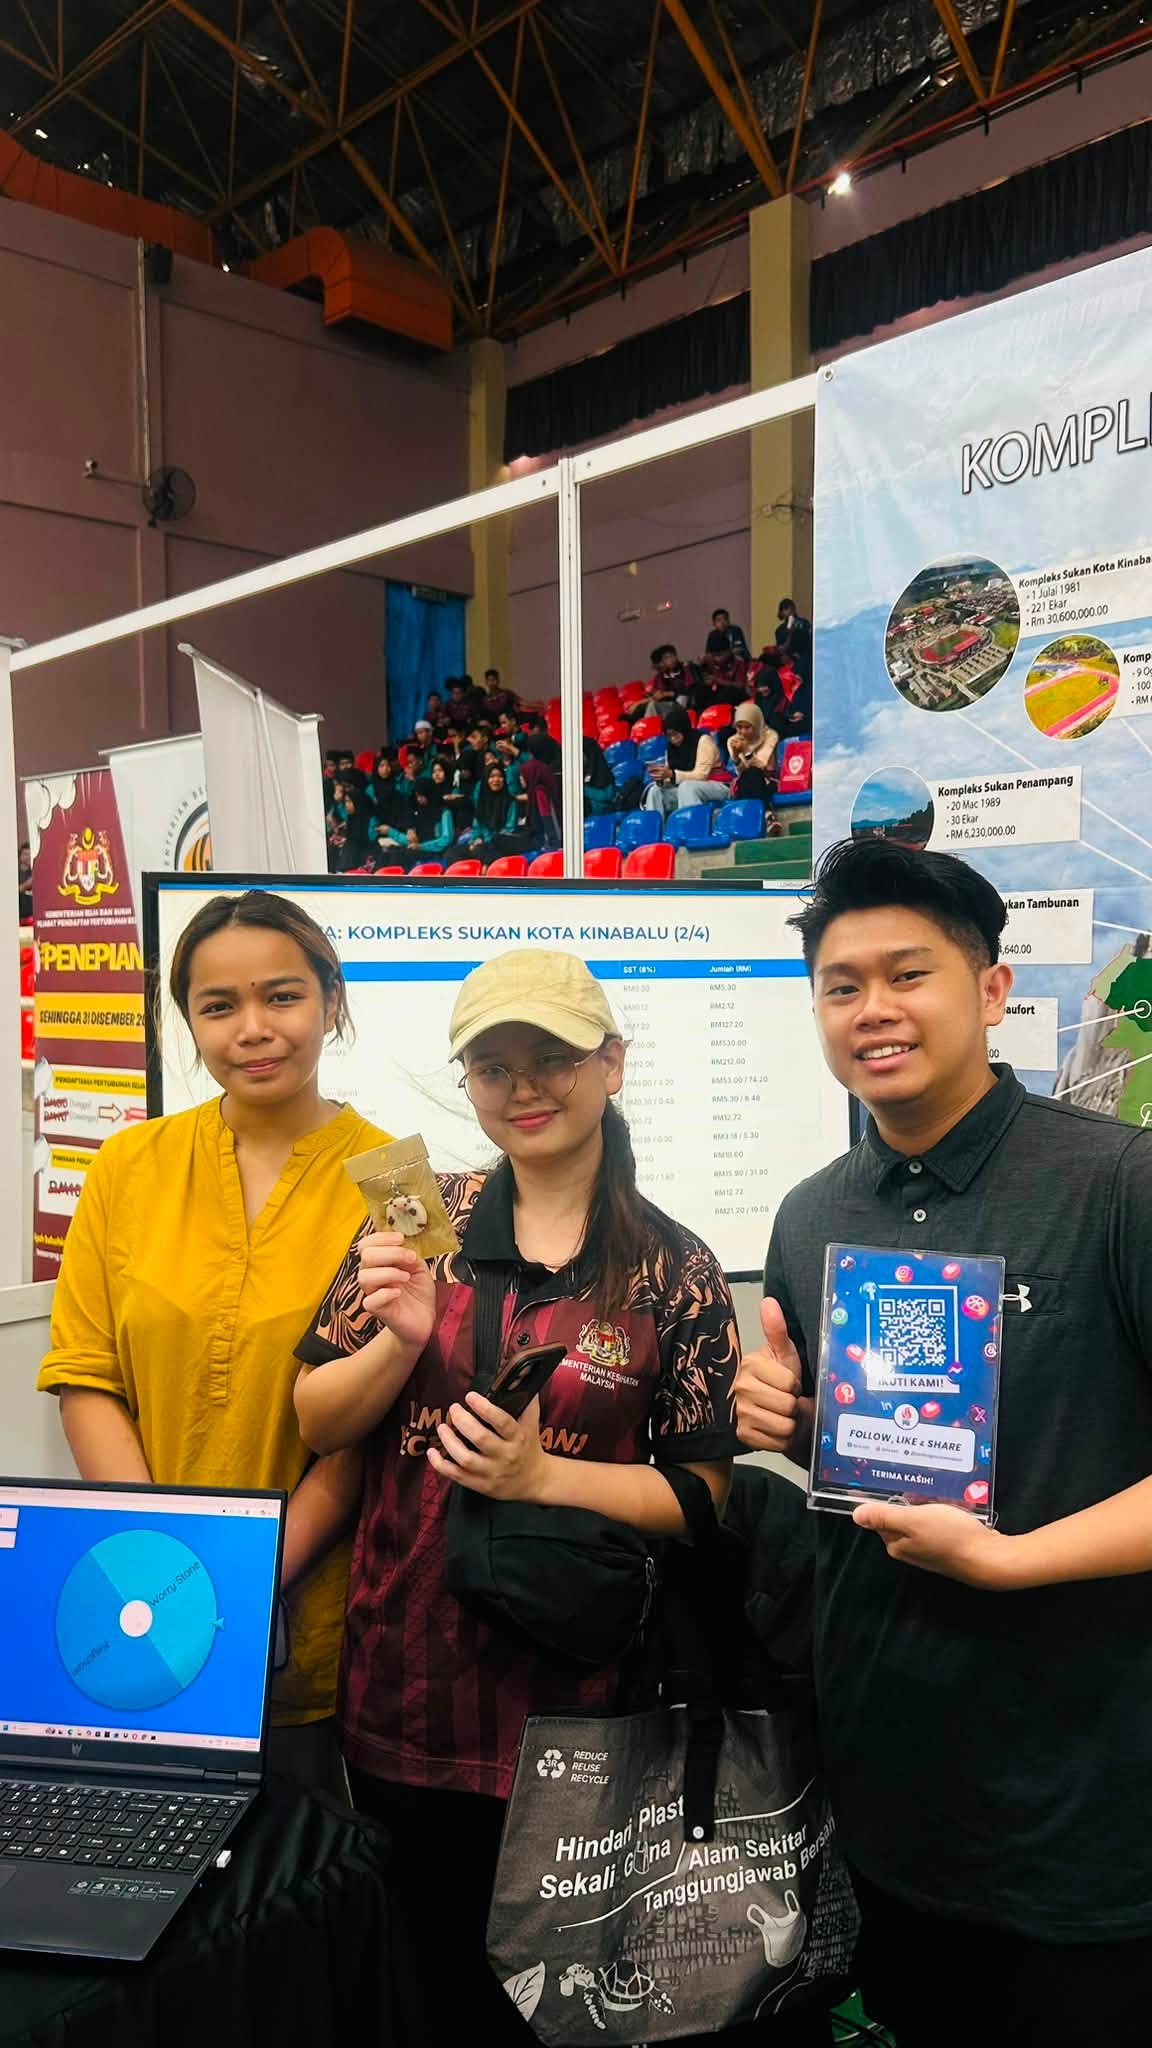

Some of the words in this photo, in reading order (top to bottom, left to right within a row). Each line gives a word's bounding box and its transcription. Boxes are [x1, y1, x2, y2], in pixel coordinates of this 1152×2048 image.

[962, 391, 1152, 494] KOMPL
[1019, 573, 1061, 588] Kompleks
[1063, 567, 1091, 580] Sukan
[1093, 562, 1115, 573] Kota
[1118, 555, 1152, 569] Kinaba
[1038, 585, 1058, 599] Julai
[1060, 582, 1080, 595] 1981
[1032, 602, 1046, 613] 221
[1049, 600, 1067, 610] Ekar
[1031, 617, 1045, 627] Rm
[1048, 605, 1109, 625] 30,600,000.00
[1123, 652, 1152, 665] Komp
[1137, 681, 1151, 690] 100
[1136, 696, 1149, 704] RM
[938, 784, 982, 797] Kompleks
[985, 781, 1014, 792] Sukan
[1016, 776, 1073, 789] Penampang
[951, 801, 961, 811] 20
[962, 800, 978, 809] Mac
[981, 797, 1001, 808] 1989
[951, 815, 960, 825] 30
[962, 814, 978, 824] Ekar
[950, 830, 963, 839] RM
[964, 825, 1016, 839] 6,230,000.00
[1027, 898, 1079, 909] Tambunan
[349, 926, 453, 940] KOMPLEKS
[458, 926, 520, 940] SUKAN
[527, 926, 574, 940] KOTA
[580, 926, 668, 940] KINABALU
[674, 925, 710, 943] (2/4)
[623, 966, 637, 974] SST
[1006, 1003, 1035, 1015] aufort
[40, 1010, 81, 1025] SEHINGGA
[91, 1011, 135, 1026] DISEMBER
[560, 1358, 606, 1377] MENTERIAN
[580, 1372, 615, 1390] MALAYSIA
[910, 1378, 944, 1388] KAMI!
[849, 1429, 894, 1445] FOLLOW,
[896, 1436, 917, 1447] LIKE
[927, 1440, 962, 1452] SHARE
[871, 1469, 903, 1481] TERIMA
[149, 1583, 178, 1608] Worry
[175, 1561, 201, 1585] Stone
[573, 1750, 609, 1761] REDUCE
[545, 1759, 558, 1768] 3R
[571, 1762, 600, 1773] REUSE
[570, 1773, 610, 1785] RECYCLE
[555, 1817, 633, 1862] Hindari
[638, 1794, 685, 1832] Plast
[689, 1845, 740, 1870] Alam
[746, 1824, 807, 1858] Sekitar
[539, 1863, 616, 1899] Sekali
[644, 1859, 797, 1913] Tanggungjawab
